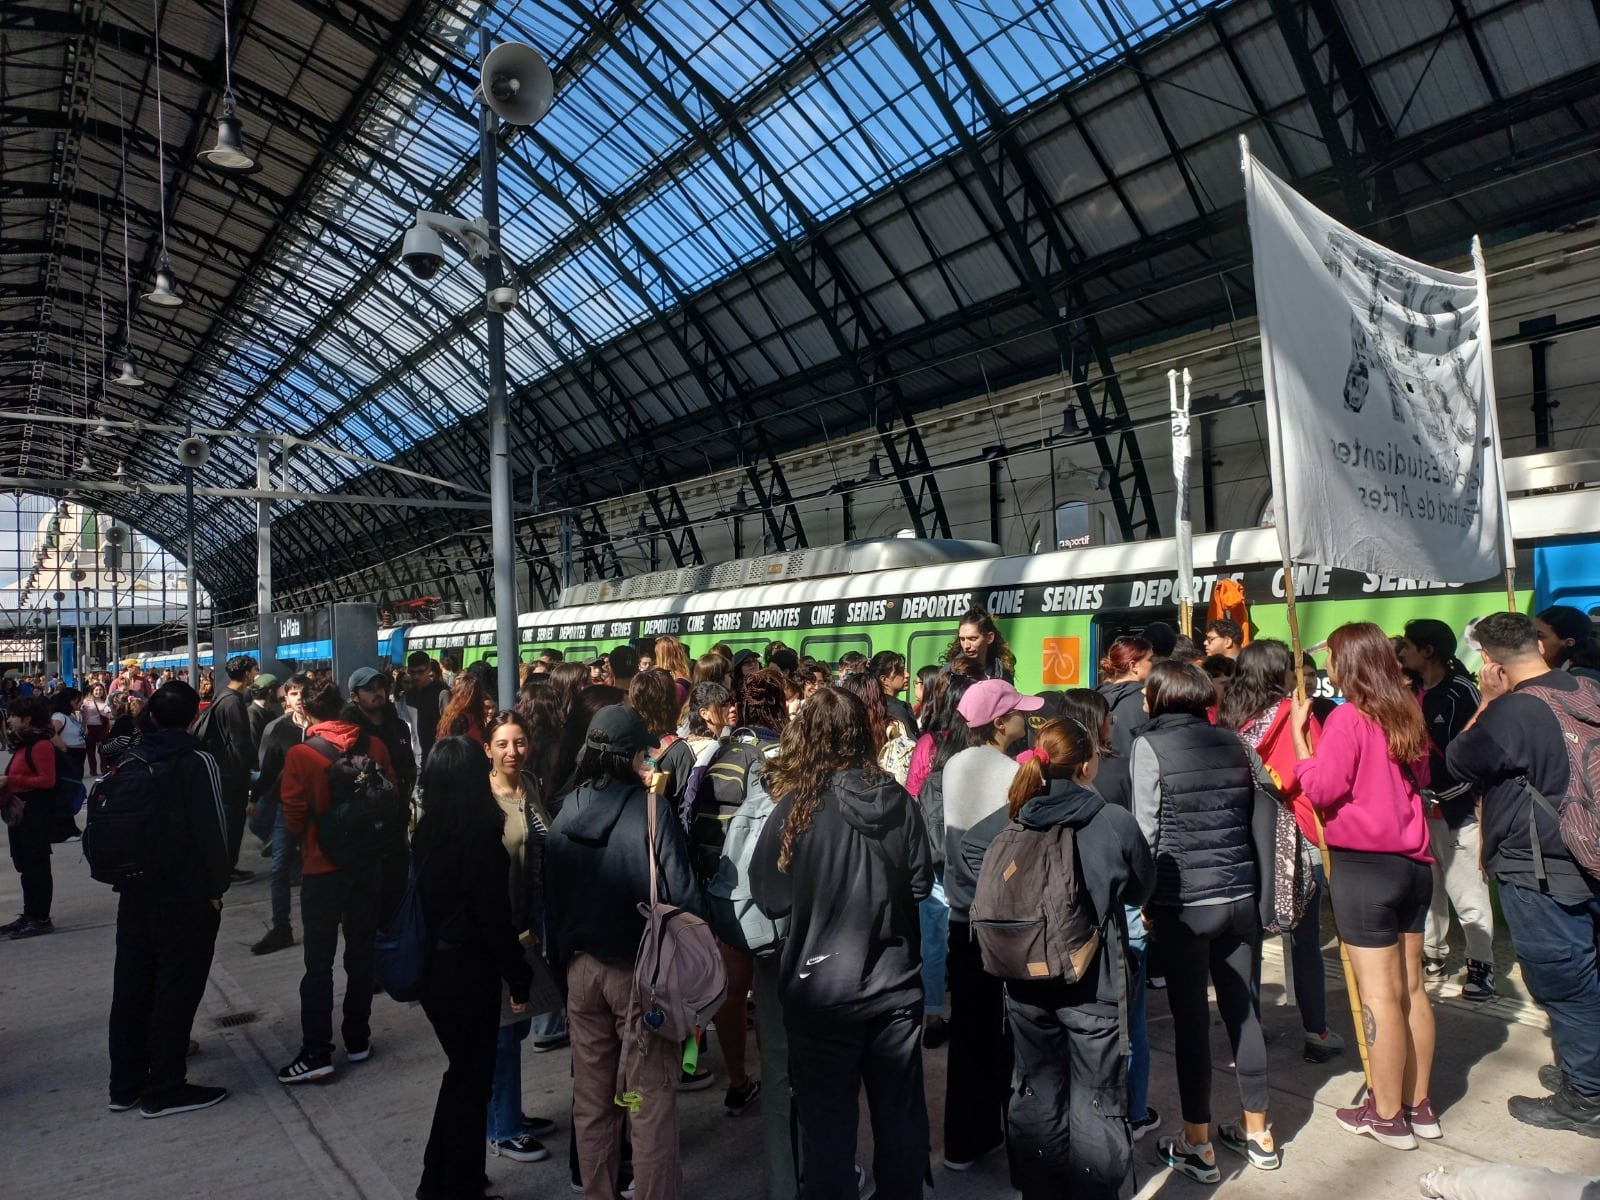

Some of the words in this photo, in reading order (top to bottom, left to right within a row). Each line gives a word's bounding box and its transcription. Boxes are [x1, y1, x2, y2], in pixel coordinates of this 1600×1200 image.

[536, 627, 554, 641] SERIES
[558, 625, 587, 640] DEPORTES
[591, 623, 606, 639] CINE
[610, 621, 632, 637] SERIES
[644, 617, 681, 635] DEPORTES
[686, 615, 706, 633] CINE
[712, 612, 742, 631] SERIES
[751, 607, 801, 629] DEPORTES
[810, 604, 836, 626] CINE
[846, 600, 888, 623] SERIES
[901, 592, 972, 620] DEPORTES
[987, 589, 1025, 615] CINE
[1041, 584, 1105, 613] SERIES
[1271, 565, 1332, 598] CNE
[280, 620, 287, 638] La
[286, 618, 300, 638] Plata
